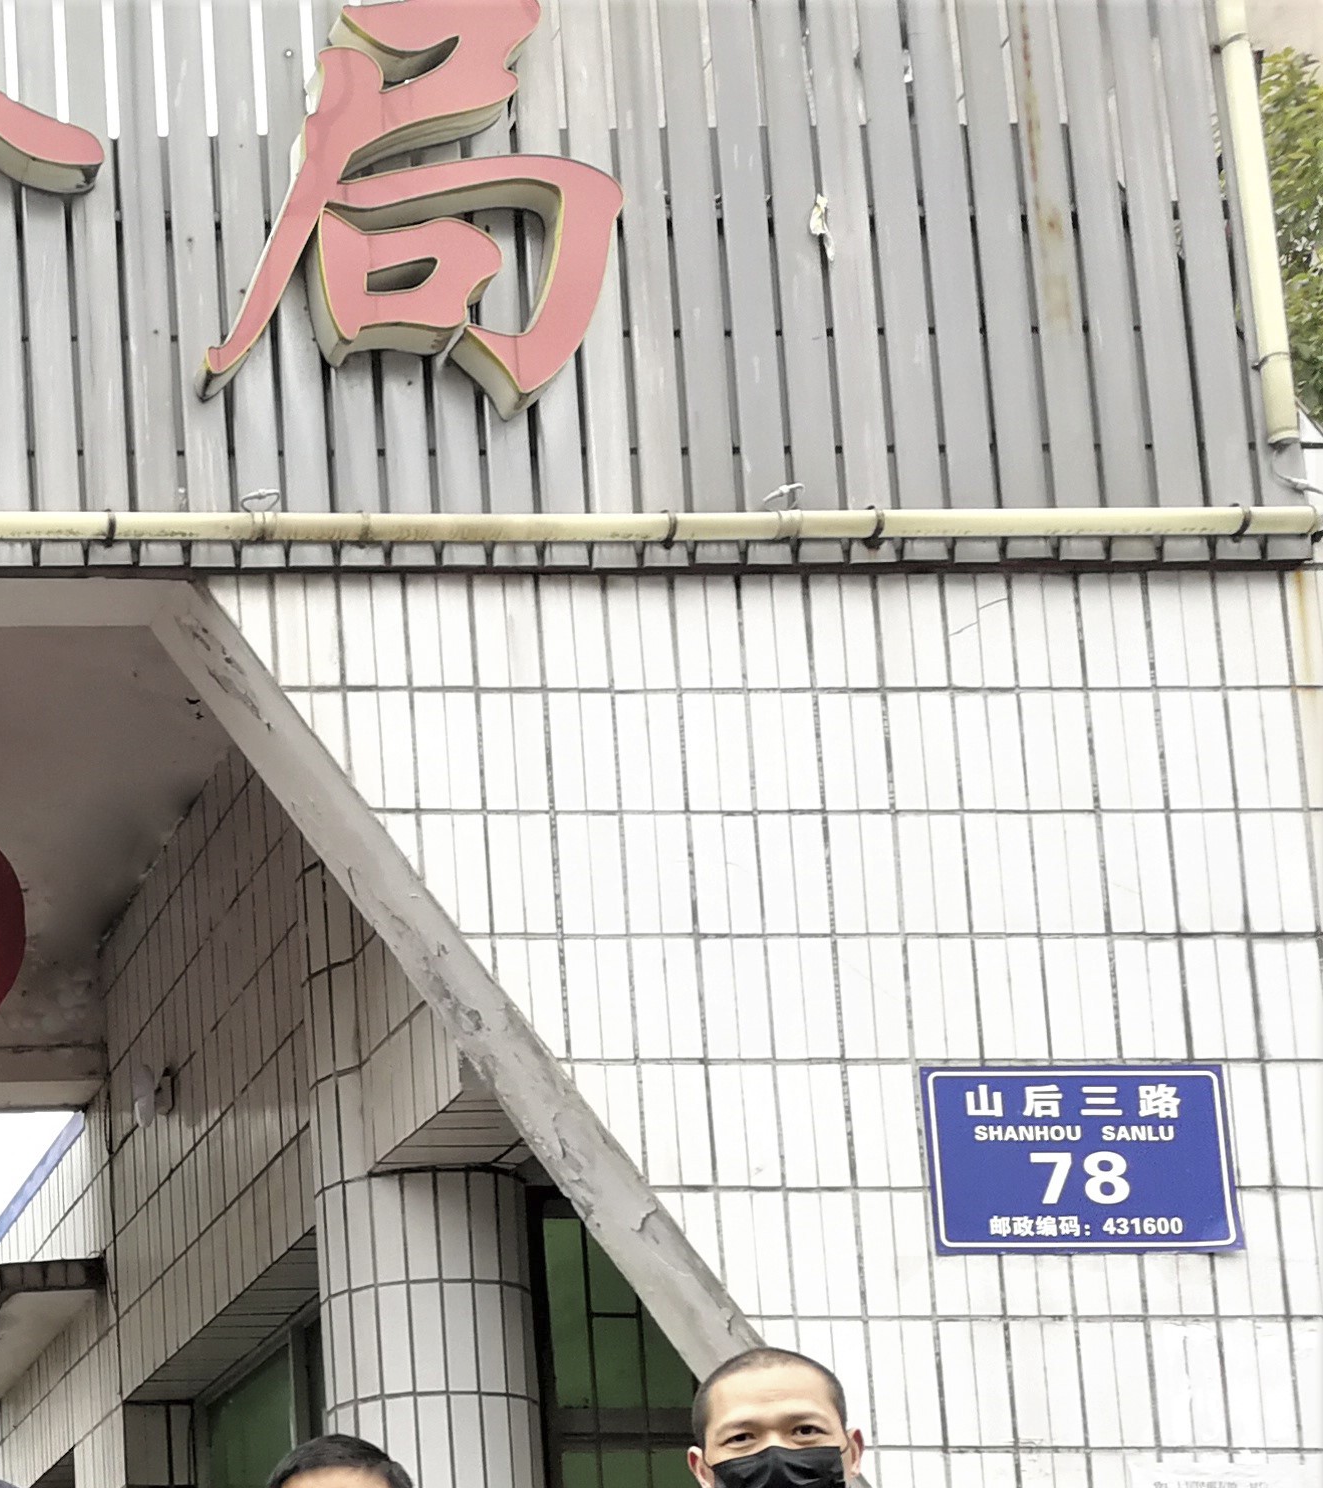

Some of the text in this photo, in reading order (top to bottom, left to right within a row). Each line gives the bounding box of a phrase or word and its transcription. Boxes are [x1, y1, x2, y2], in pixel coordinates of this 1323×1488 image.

[965, 1083, 1182, 1118] 山后三路
[974, 1125, 1175, 1142] SHANHOU SANLU
[1029, 1150, 1131, 1205] 78
